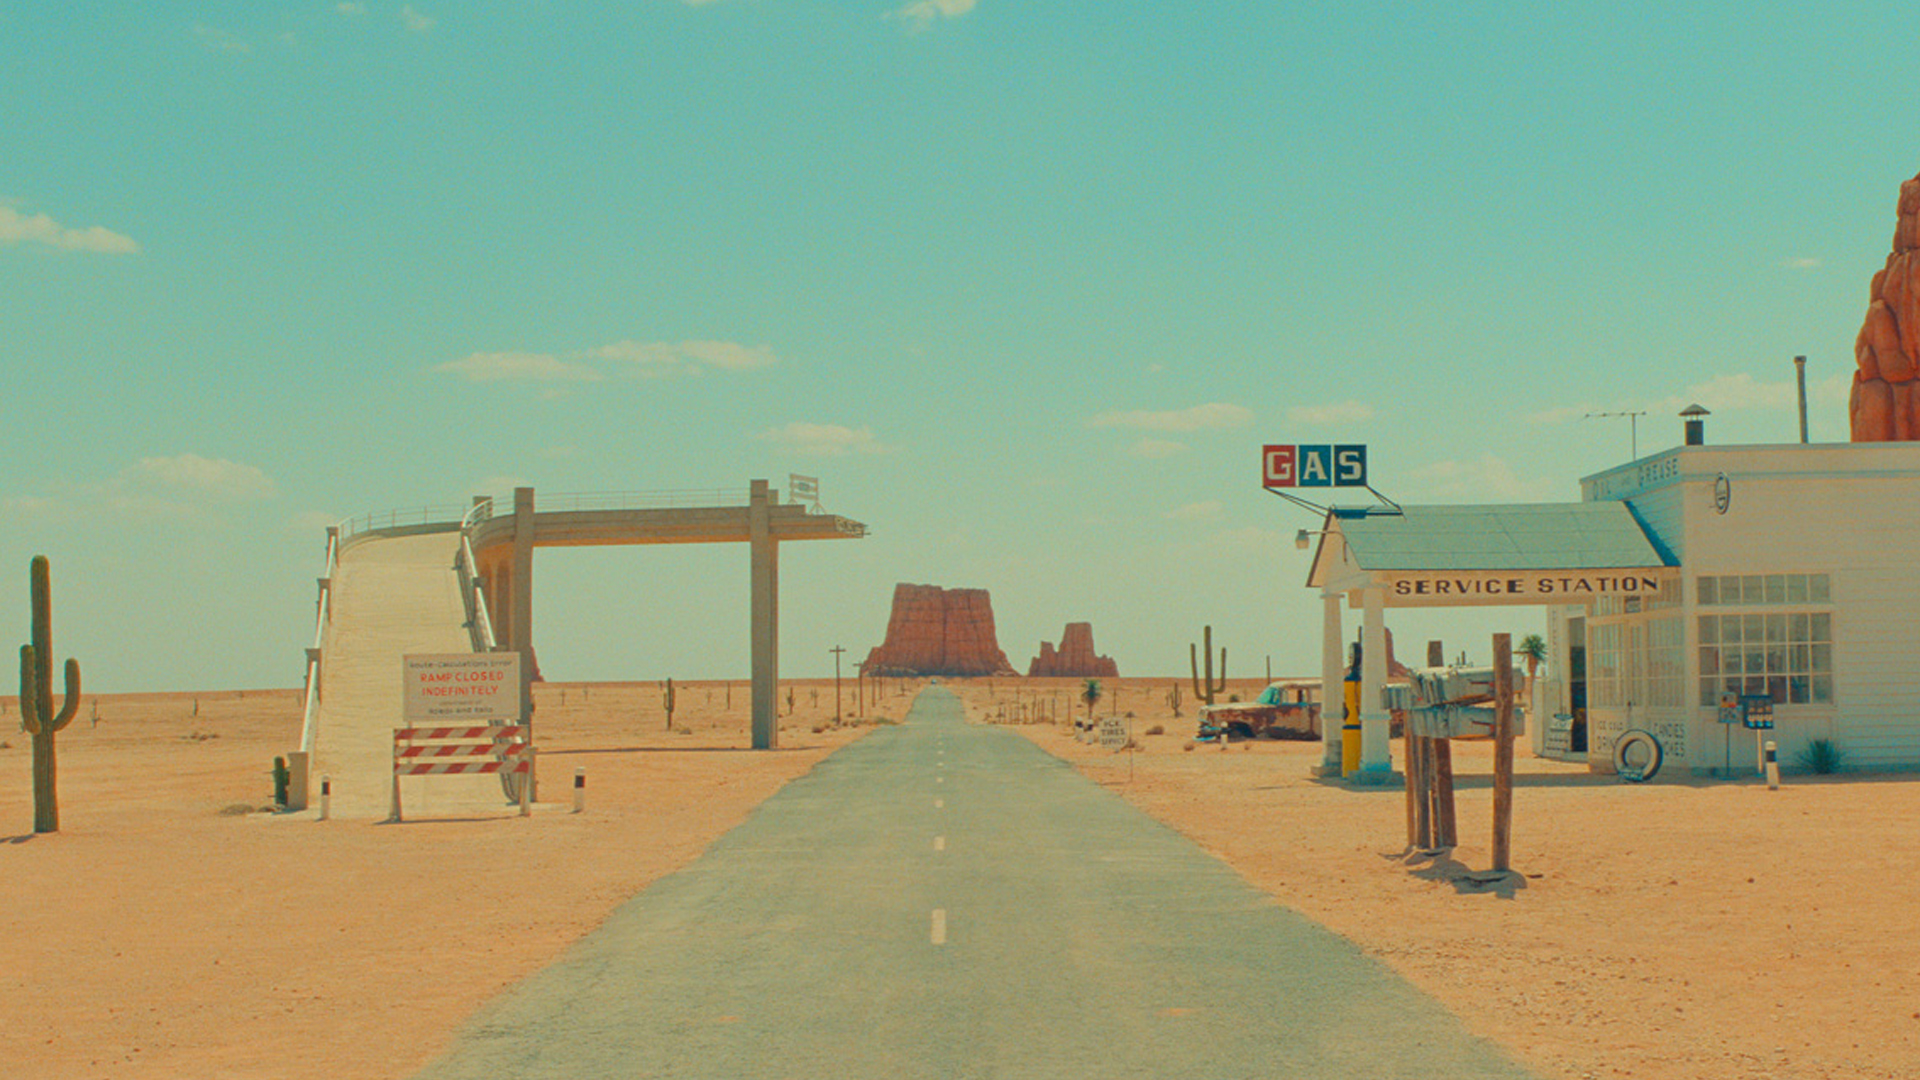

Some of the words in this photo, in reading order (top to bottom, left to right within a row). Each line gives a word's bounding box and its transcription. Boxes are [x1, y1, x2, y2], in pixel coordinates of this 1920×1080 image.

[1266, 451, 1361, 480] GAS
[1638, 457, 1678, 488] GREASE
[1396, 579, 1524, 595] SERVICE
[1537, 576, 1659, 593] STATION
[420, 672, 453, 682] RAMP
[455, 670, 504, 682] CLOSED
[422, 685, 499, 697] INDEFINITELY
